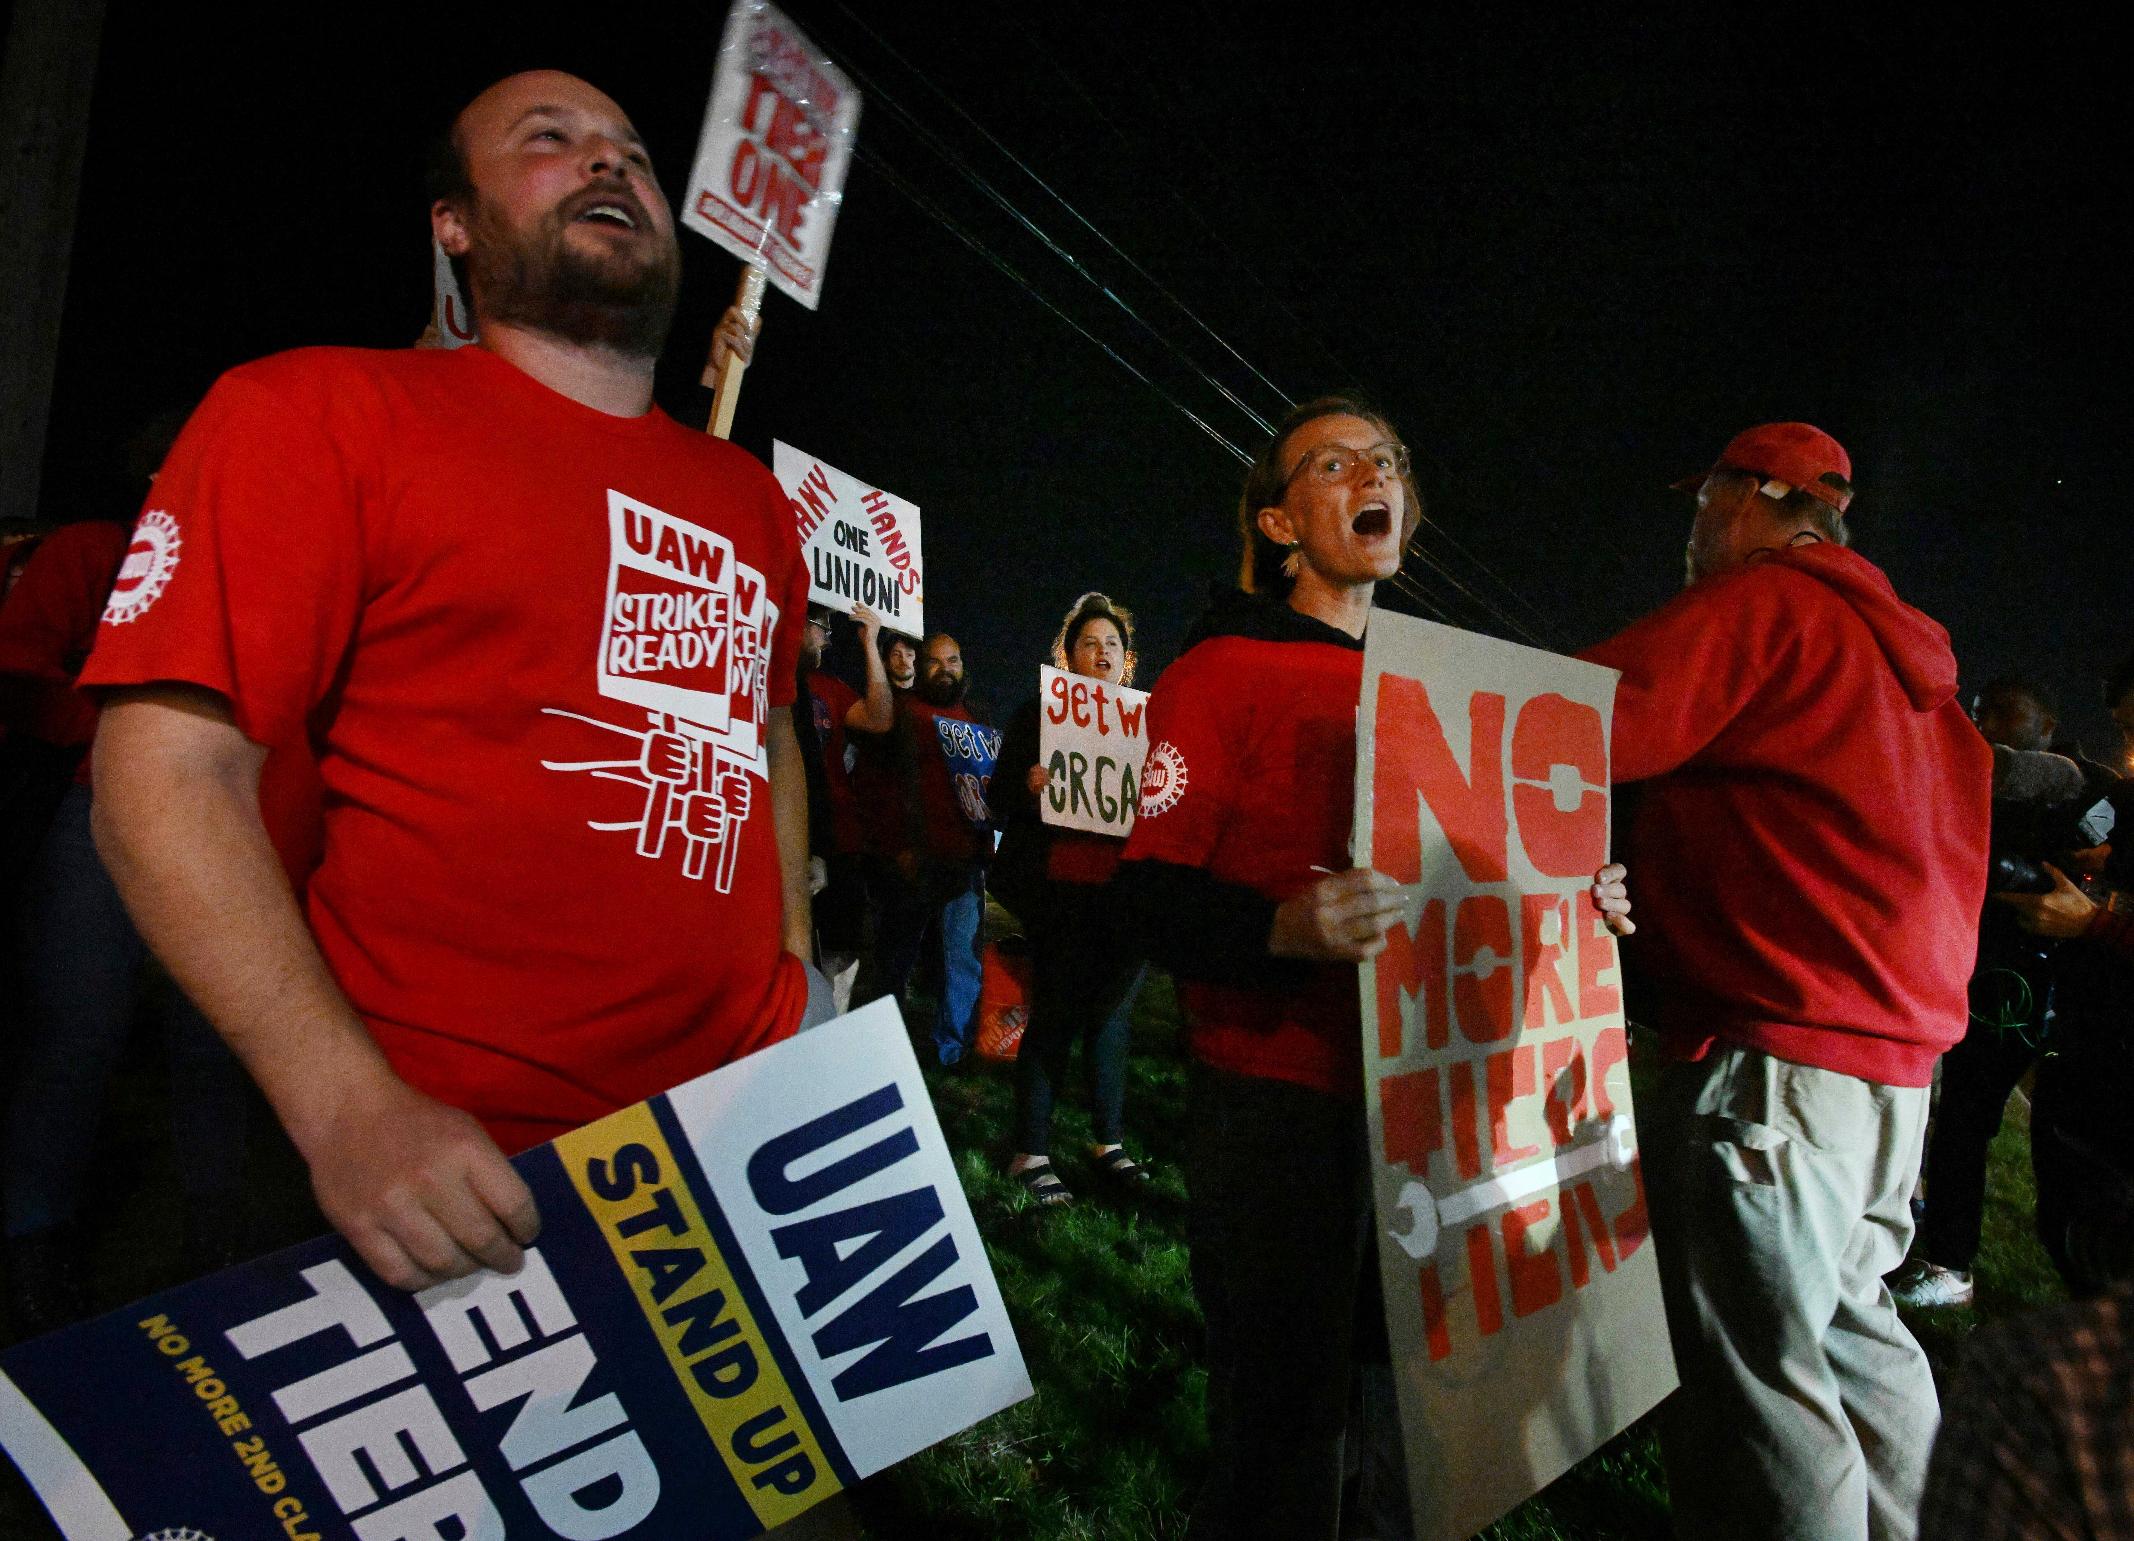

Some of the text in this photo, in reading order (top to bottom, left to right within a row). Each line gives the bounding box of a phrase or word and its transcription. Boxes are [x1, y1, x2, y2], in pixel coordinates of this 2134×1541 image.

[731, 138, 811, 253] ONE
[622, 507, 726, 585] UAW
[790, 463, 921, 595] ANY HANDS
[813, 546, 900, 618] UNION!
[833, 519, 870, 558] ONE
[607, 629, 726, 676] READY
[613, 591, 730, 634] STRIKE
[1047, 676, 1110, 737] get
[1371, 672, 1608, 885] NO
[1376, 888, 1620, 1058] MORE
[746, 1081, 996, 1404] UAW
[587, 1142, 817, 1496] STAND UP
[137, 1313, 191, 1357] NO
[175, 1354, 253, 1438] MORE
[233, 1435, 288, 1495] 2ND
[412, 1246, 661, 1541] END
